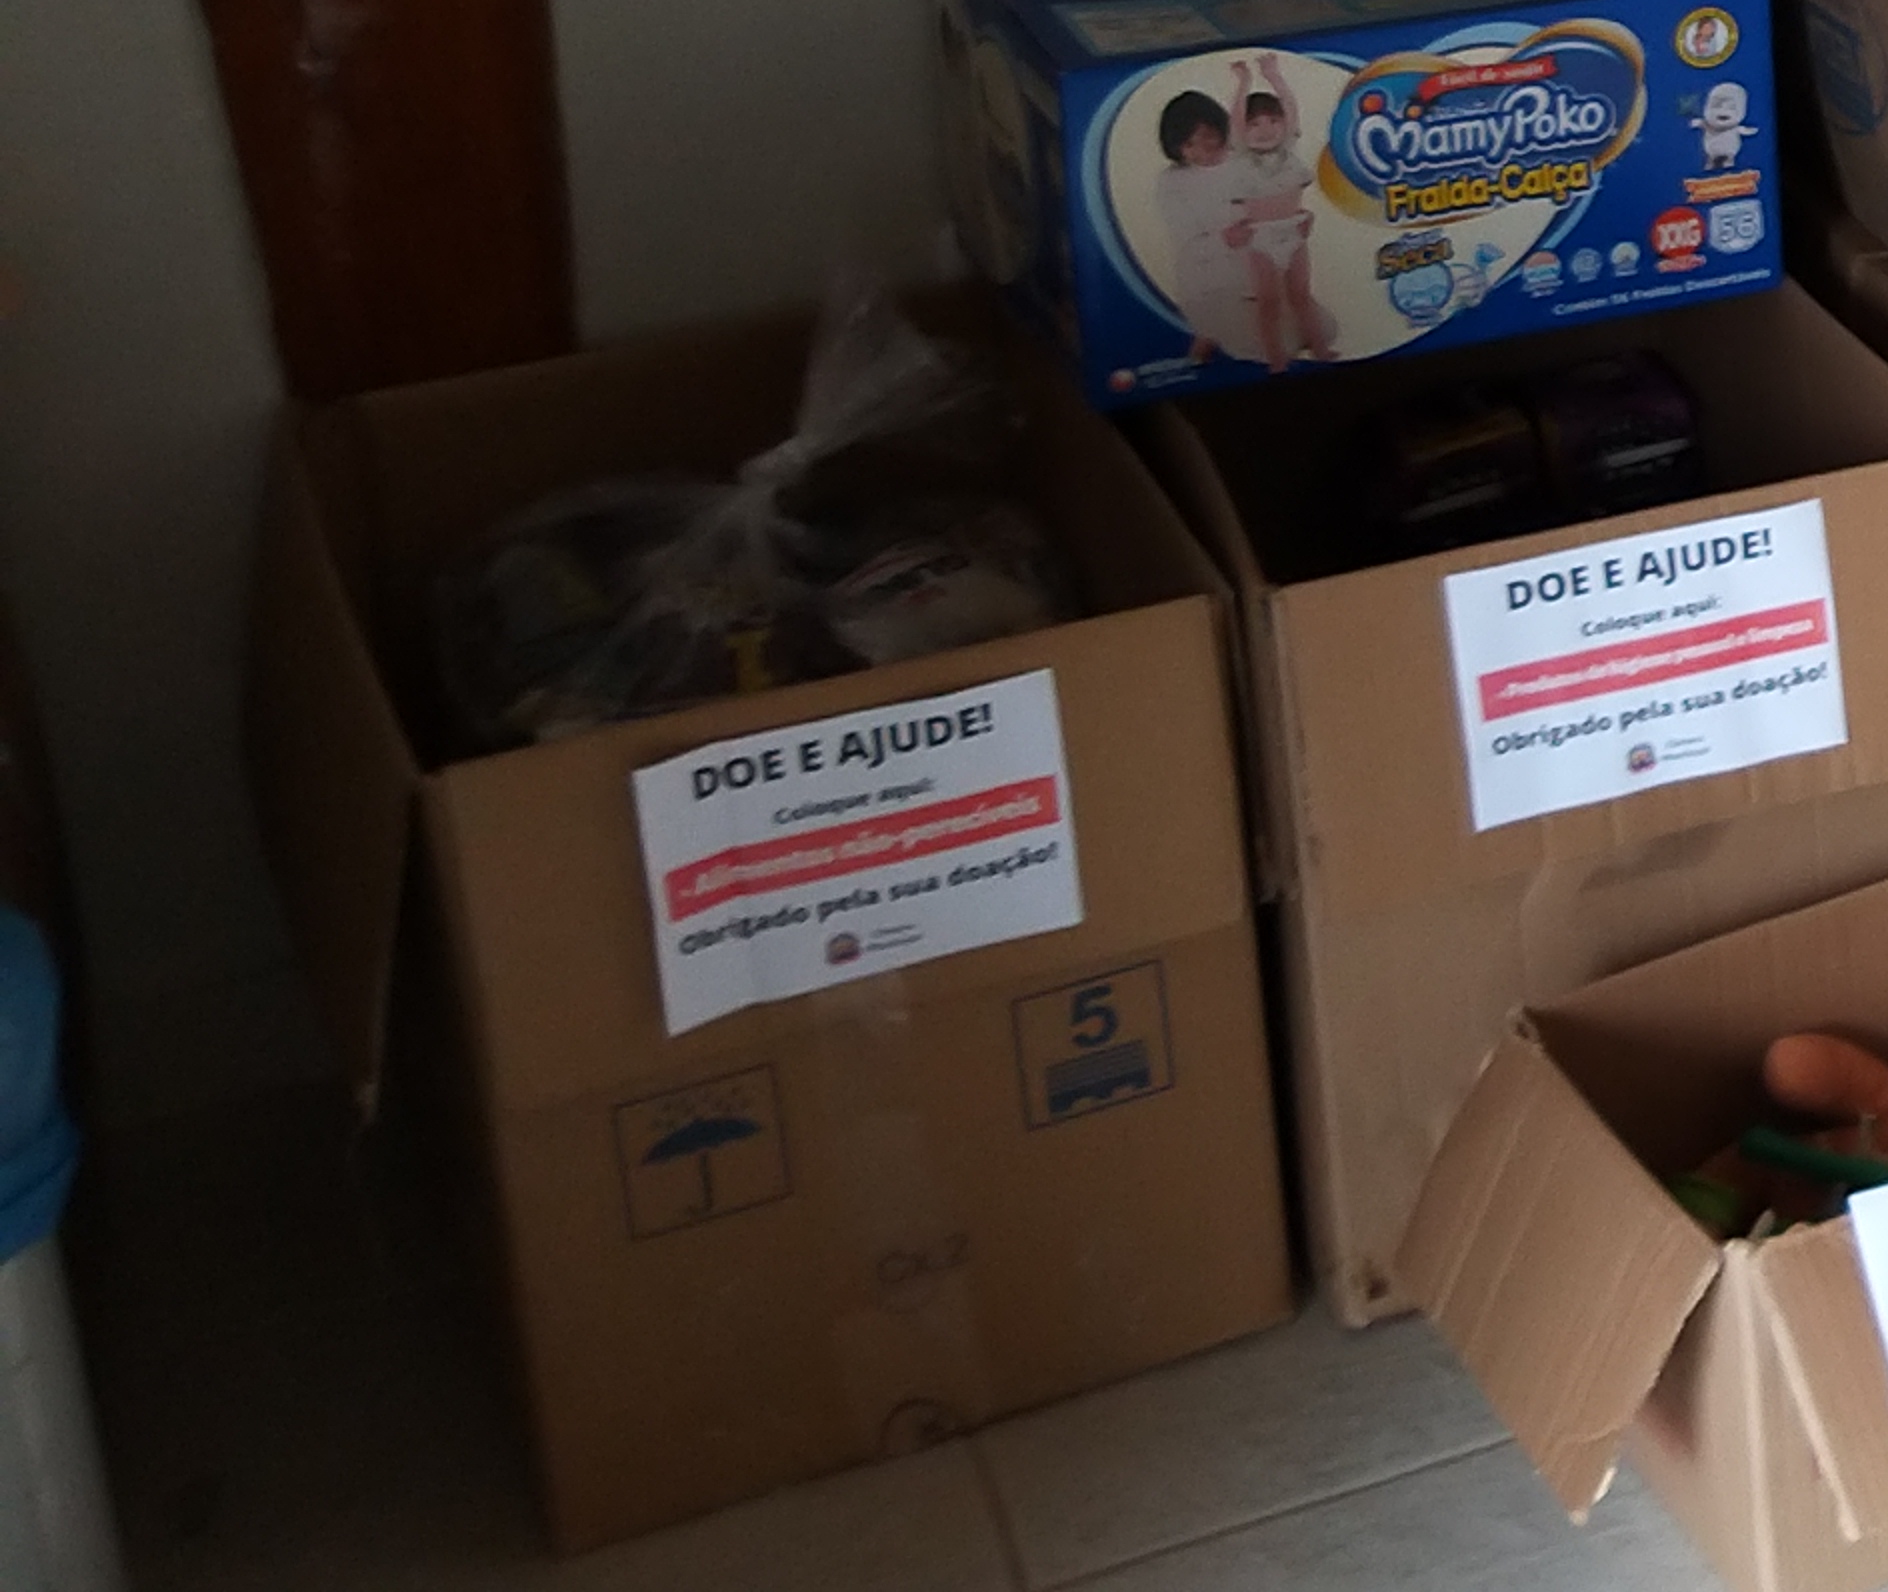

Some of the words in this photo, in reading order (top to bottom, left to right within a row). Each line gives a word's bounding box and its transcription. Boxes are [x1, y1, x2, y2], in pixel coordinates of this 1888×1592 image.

[1356, 85, 1606, 174] MamyPoko
[1385, 159, 1592, 223] Fralda-Calça
[1505, 565, 1591, 611] DOE
[1603, 557, 1623, 590] E
[1637, 527, 1773, 586] AJUDE!
[1581, 607, 1666, 639] Coloque
[1671, 595, 1722, 619] aqui:
[1491, 714, 1612, 757] Obrigado
[1620, 699, 1674, 729] pela
[1682, 689, 1726, 713] sua
[1731, 661, 1829, 702] doação!
[691, 747, 787, 802] DOE
[800, 739, 823, 774] E
[837, 701, 995, 771] AJUDE!
[771, 792, 871, 826] Coloque
[877, 777, 936, 805] aqui:
[678, 907, 811, 956] Obrigado
[816, 888, 881, 923] pela
[888, 875, 941, 901] sua
[947, 842, 1060, 888] doação!
[1069, 984, 1119, 1050] 5
